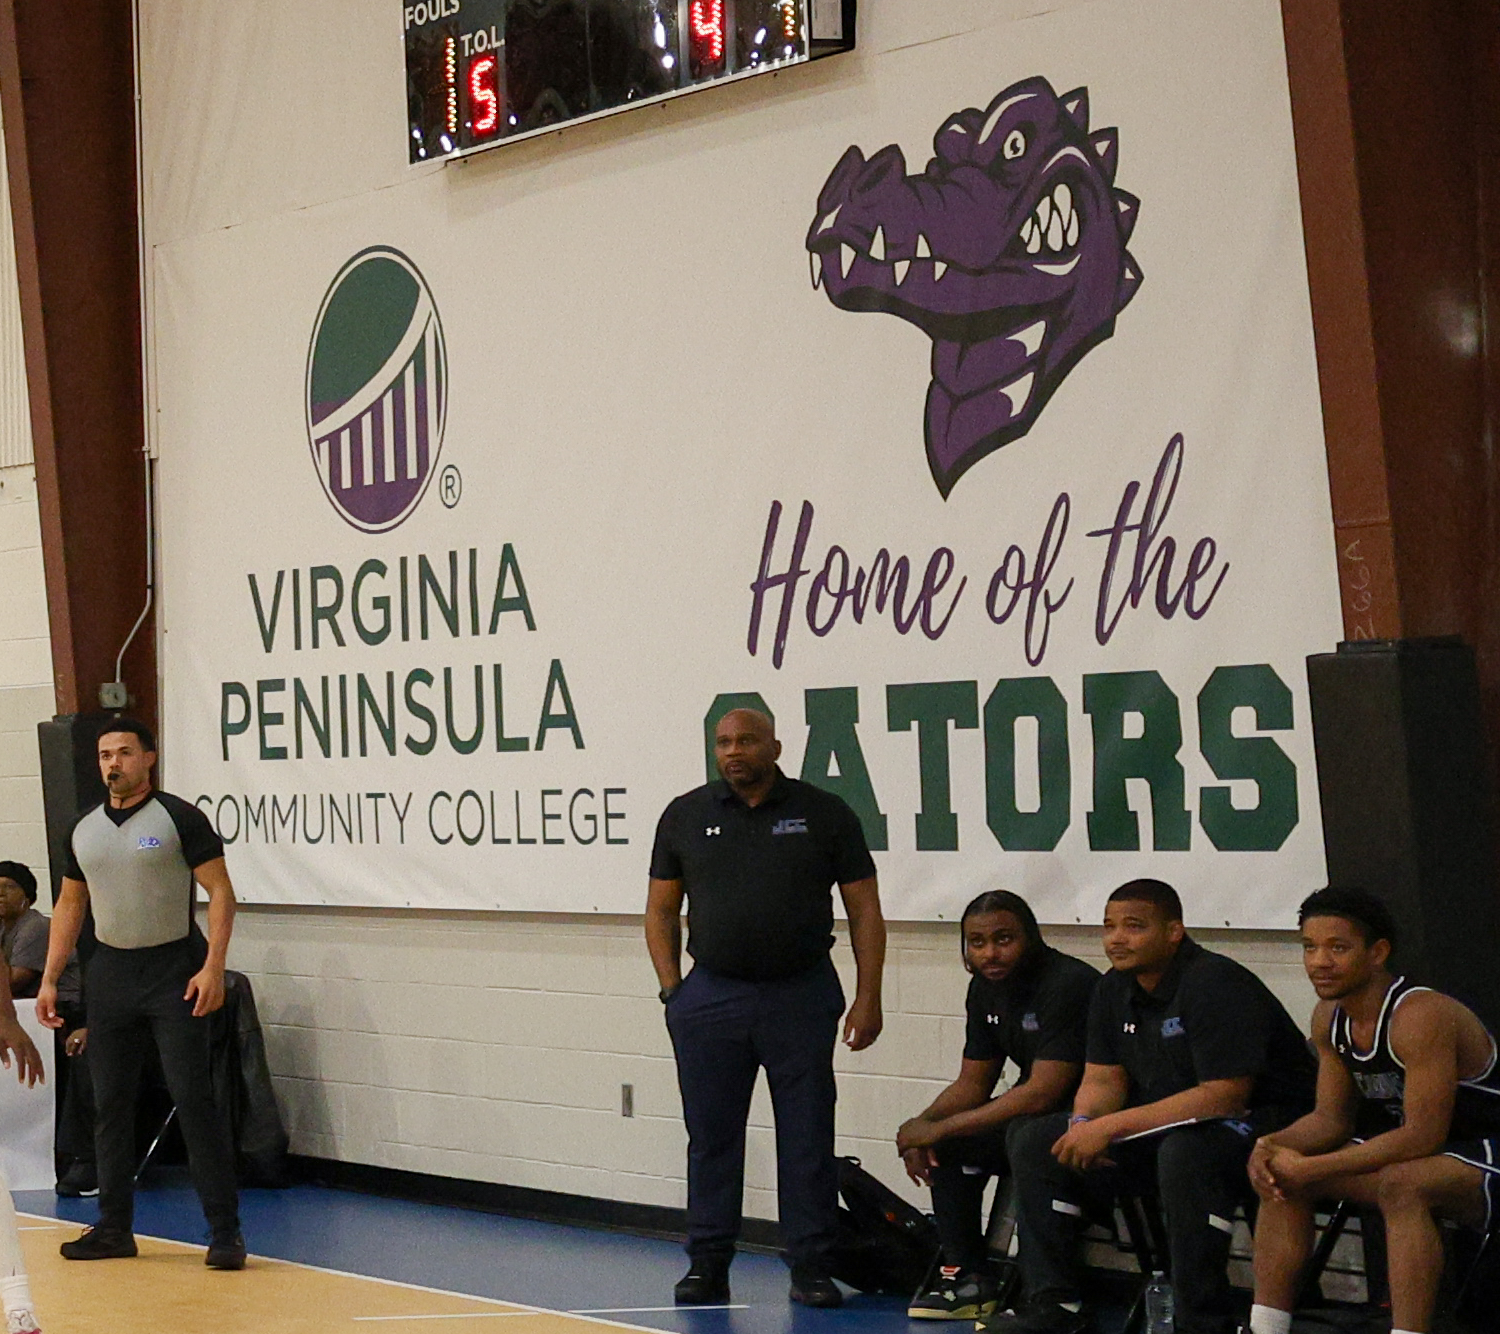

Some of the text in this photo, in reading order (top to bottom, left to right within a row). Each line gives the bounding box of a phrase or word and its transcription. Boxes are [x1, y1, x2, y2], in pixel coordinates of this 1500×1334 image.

[460, 23, 506, 56] T.O.L.
[470, 56, 497, 133] 5
[747, 432, 1230, 669] Home of the
[248, 542, 537, 653] VIRGINIA
[220, 659, 585, 763] PENINSULA
[428, 788, 630, 847] COLLEGE
